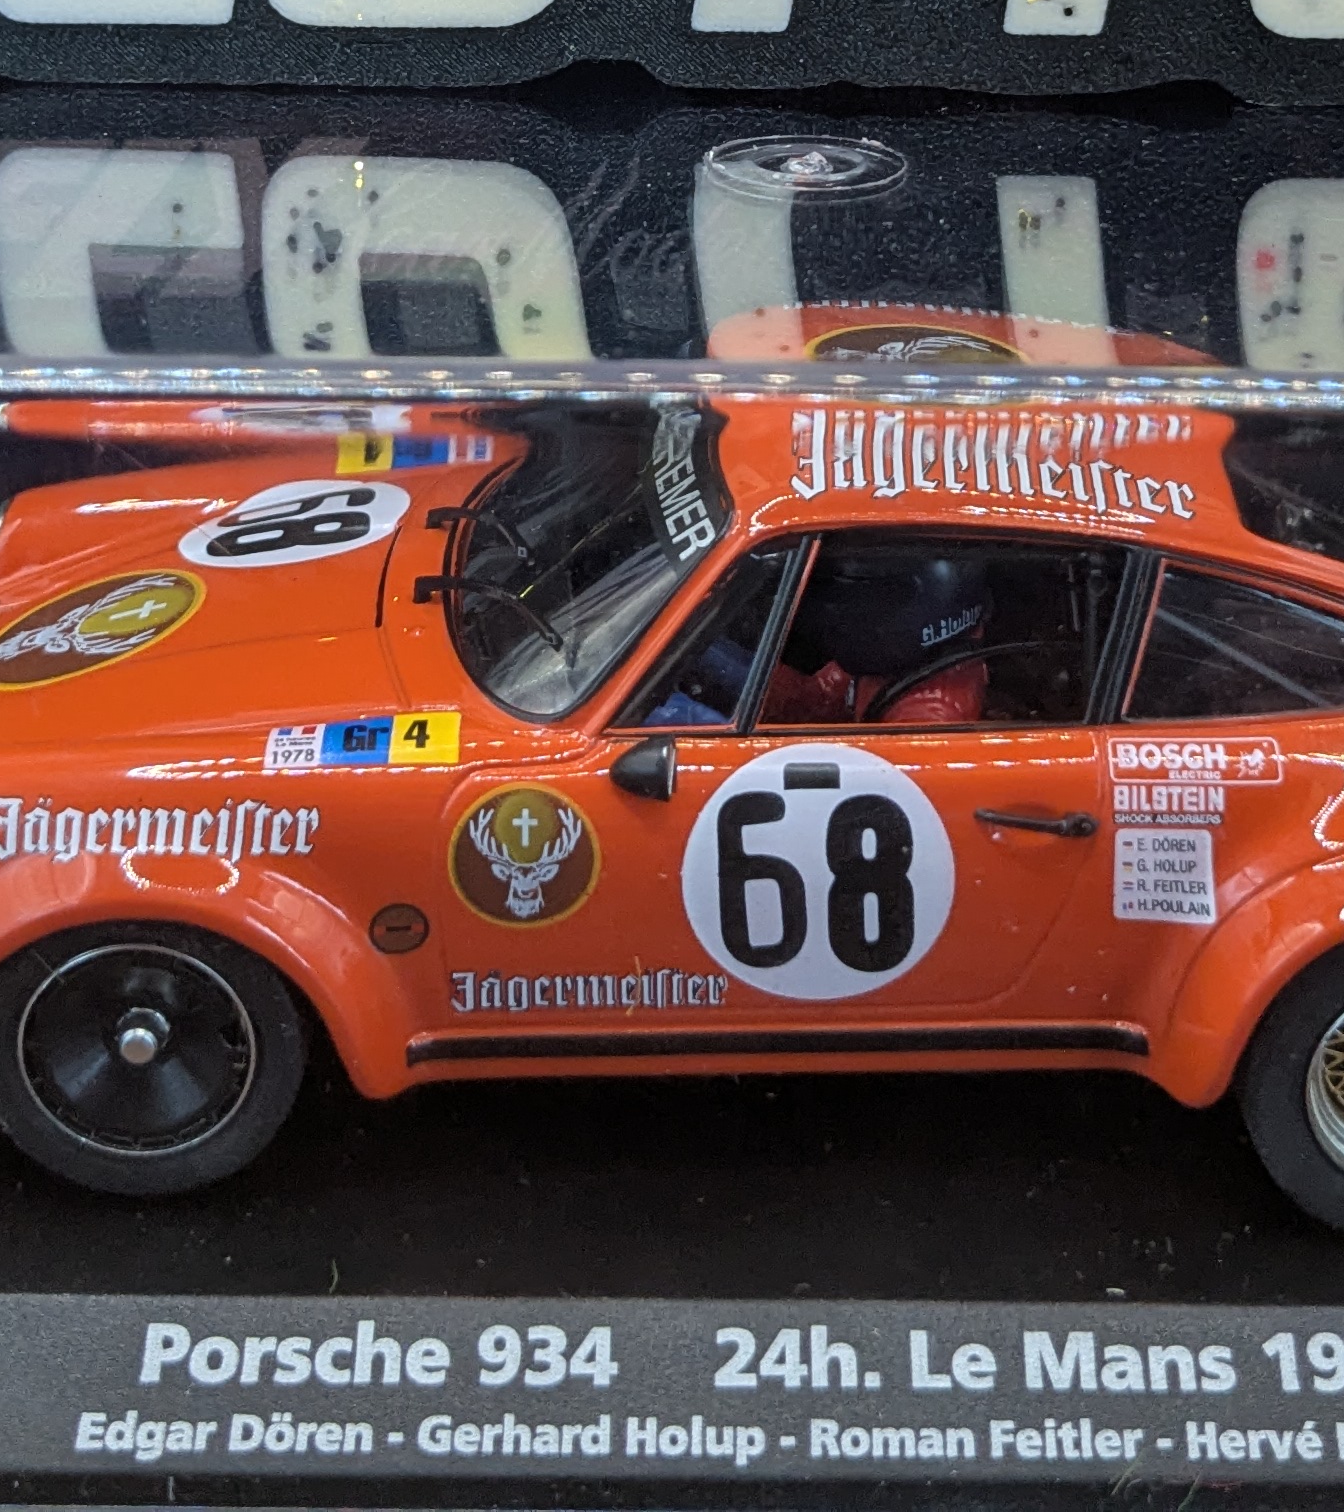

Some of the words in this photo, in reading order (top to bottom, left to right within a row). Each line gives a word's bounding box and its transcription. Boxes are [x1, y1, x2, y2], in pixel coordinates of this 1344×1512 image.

[342, 724, 391, 753] Gr
[403, 719, 431, 749] 4
[272, 748, 316, 765] 1978
[1115, 743, 1228, 770] BOSCH
[1168, 770, 1222, 780] ELECTRIC
[1113, 785, 1225, 812] BILSTEIN
[1114, 814, 1154, 824] SHOCK
[1155, 814, 1222, 824] ABSORBERS
[1152, 837, 1196, 853] DÖREN
[1136, 859, 1149, 873] G.
[1153, 859, 1197, 874] HOLUP
[715, 790, 916, 974] 68
[1154, 879, 1208, 896] FEITLER
[139, 1320, 452, 1386] Porsche
[476, 1324, 620, 1387] 934
[714, 1325, 881, 1389] 24h.
[908, 1328, 998, 1390] Le
[1022, 1330, 1238, 1391] Mans
[73, 1410, 218, 1460] Edgar
[228, 1411, 374, 1454] Dören
[416, 1413, 612, 1456] Gerhard
[624, 1415, 767, 1466] Holup
[808, 1417, 977, 1460] Roman
[988, 1418, 1145, 1461] Feitler
[1184, 1419, 1323, 1463] Hervé
